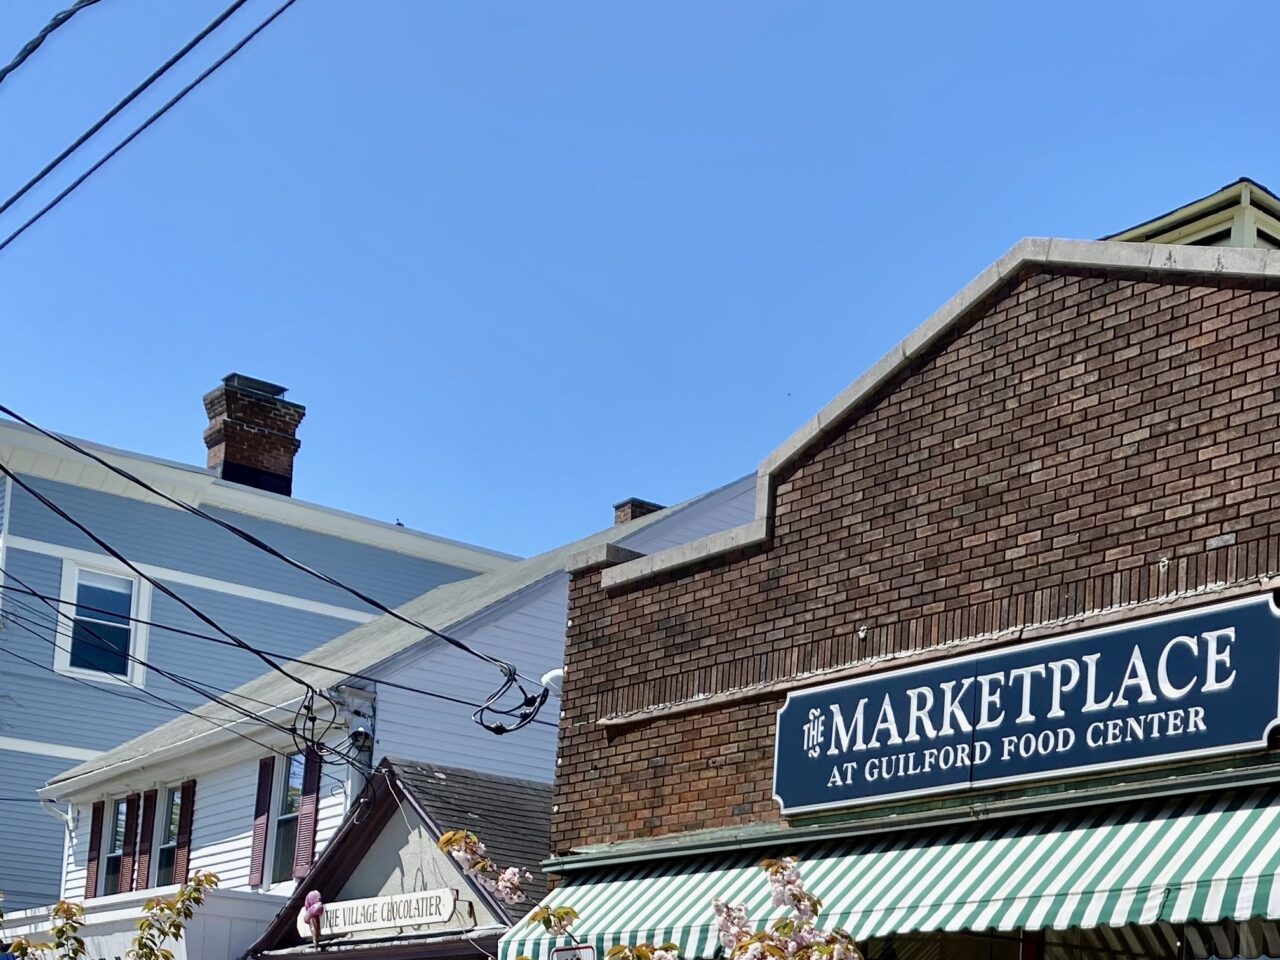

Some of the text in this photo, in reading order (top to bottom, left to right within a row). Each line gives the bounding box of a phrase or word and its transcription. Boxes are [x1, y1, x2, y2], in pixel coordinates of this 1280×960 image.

[803, 627, 1237, 756] THE MARKETPLACE
[827, 706, 1207, 788] AT GUILFORD FOOD CENTER
[324, 895, 442, 929] THE VILLAGE CHOCOLATIER
